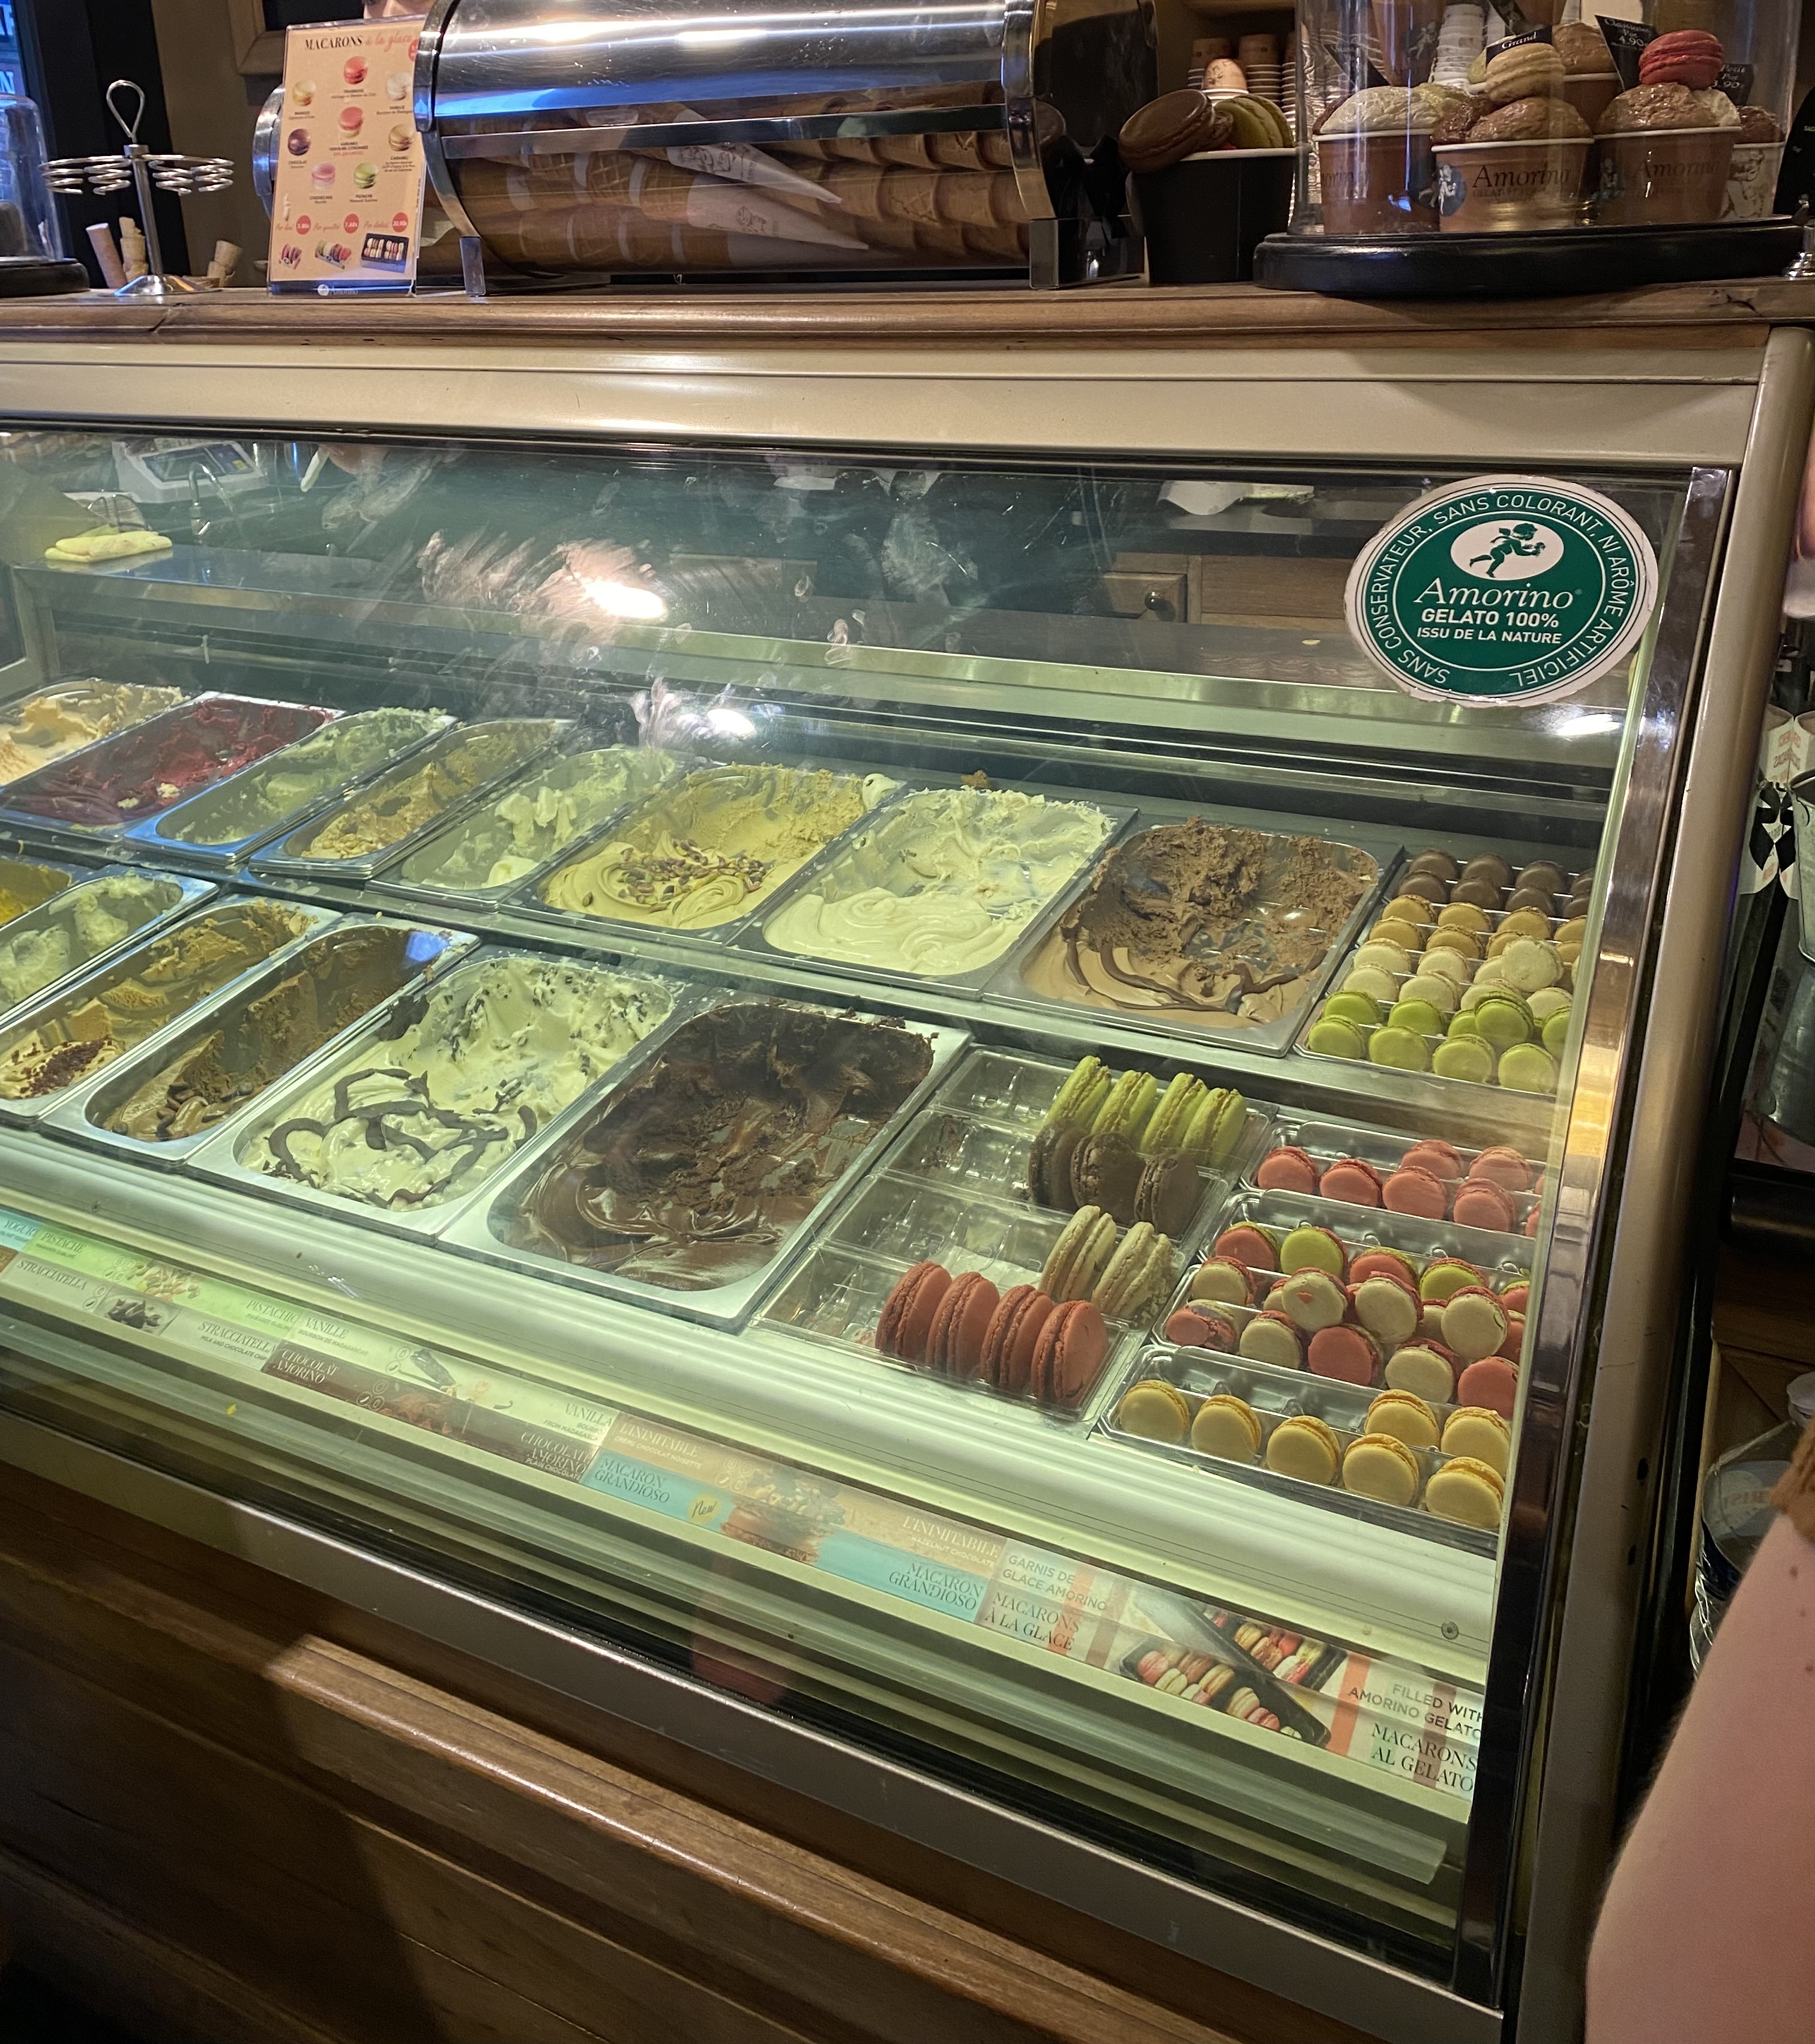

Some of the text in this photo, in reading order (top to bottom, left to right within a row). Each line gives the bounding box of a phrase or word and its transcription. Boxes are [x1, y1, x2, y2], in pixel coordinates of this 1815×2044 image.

[305, 35, 363, 50] MACARONS
[1502, 31, 1537, 49] Grand
[1472, 163, 1571, 188] Amorino
[1370, 494, 1635, 687] SANS CONSERVATEUR, SANS COLORANT, NI ARÔME ARTIFICIEL
[1413, 577, 1574, 609] Amorino
[1421, 608, 1560, 628] GELATO 100%
[1416, 627, 1562, 645] ISSU DE LA NATURE
[40, 1232, 86, 1254] PISTACHE
[17, 1260, 87, 1291] STRACCIATELLA
[298, 1329, 324, 1342] BOURBON
[324, 1335, 333, 1344] DE
[306, 1317, 350, 1339] VANILLE
[212, 1339, 224, 1347] AND
[224, 1342, 255, 1357] CHOCOLATE
[281, 1349, 340, 1376] CHOCOLAT
[272, 1360, 326, 1384] AMORINO
[543, 1419, 561, 1430] FROM
[565, 1402, 613, 1428] VANILLA
[521, 1431, 591, 1464] CHOCOLATE
[619, 1422, 701, 1458] L'INIMITABLE
[525, 1457, 582, 1481] PLAIN CHOCOLATE
[527, 1447, 586, 1474] AMORINO
[636, 1442, 670, 1459] CHOCOLAT
[670, 1453, 703, 1470] NOISETTE
[594, 1469, 670, 1504] GRANDIOSO
[600, 1458, 666, 1489] MACARON
[691, 1500, 718, 1518] New
[902, 1515, 1002, 1559] L'INIMITABILE
[911, 1536, 997, 1569] HAZELNUT CHOCOLATE
[906, 1562, 985, 1598] MACARON
[1008, 1554, 1077, 1584] GARNIS DE
[889, 1571, 978, 1611] GRANDIOSO
[1003, 1568, 1107, 1611] GLACE AMORINO
[992, 1591, 1082, 1632] MACARONS
[999, 1611, 1019, 1632] LA
[1023, 1622, 1076, 1651] GLACE
[1347, 1686, 1420, 1719] AMORINO
[1392, 1683, 1443, 1709] FILLED
[1371, 1722, 1477, 1772] MACARONS
[1371, 1746, 1474, 1793] AL GELATO
